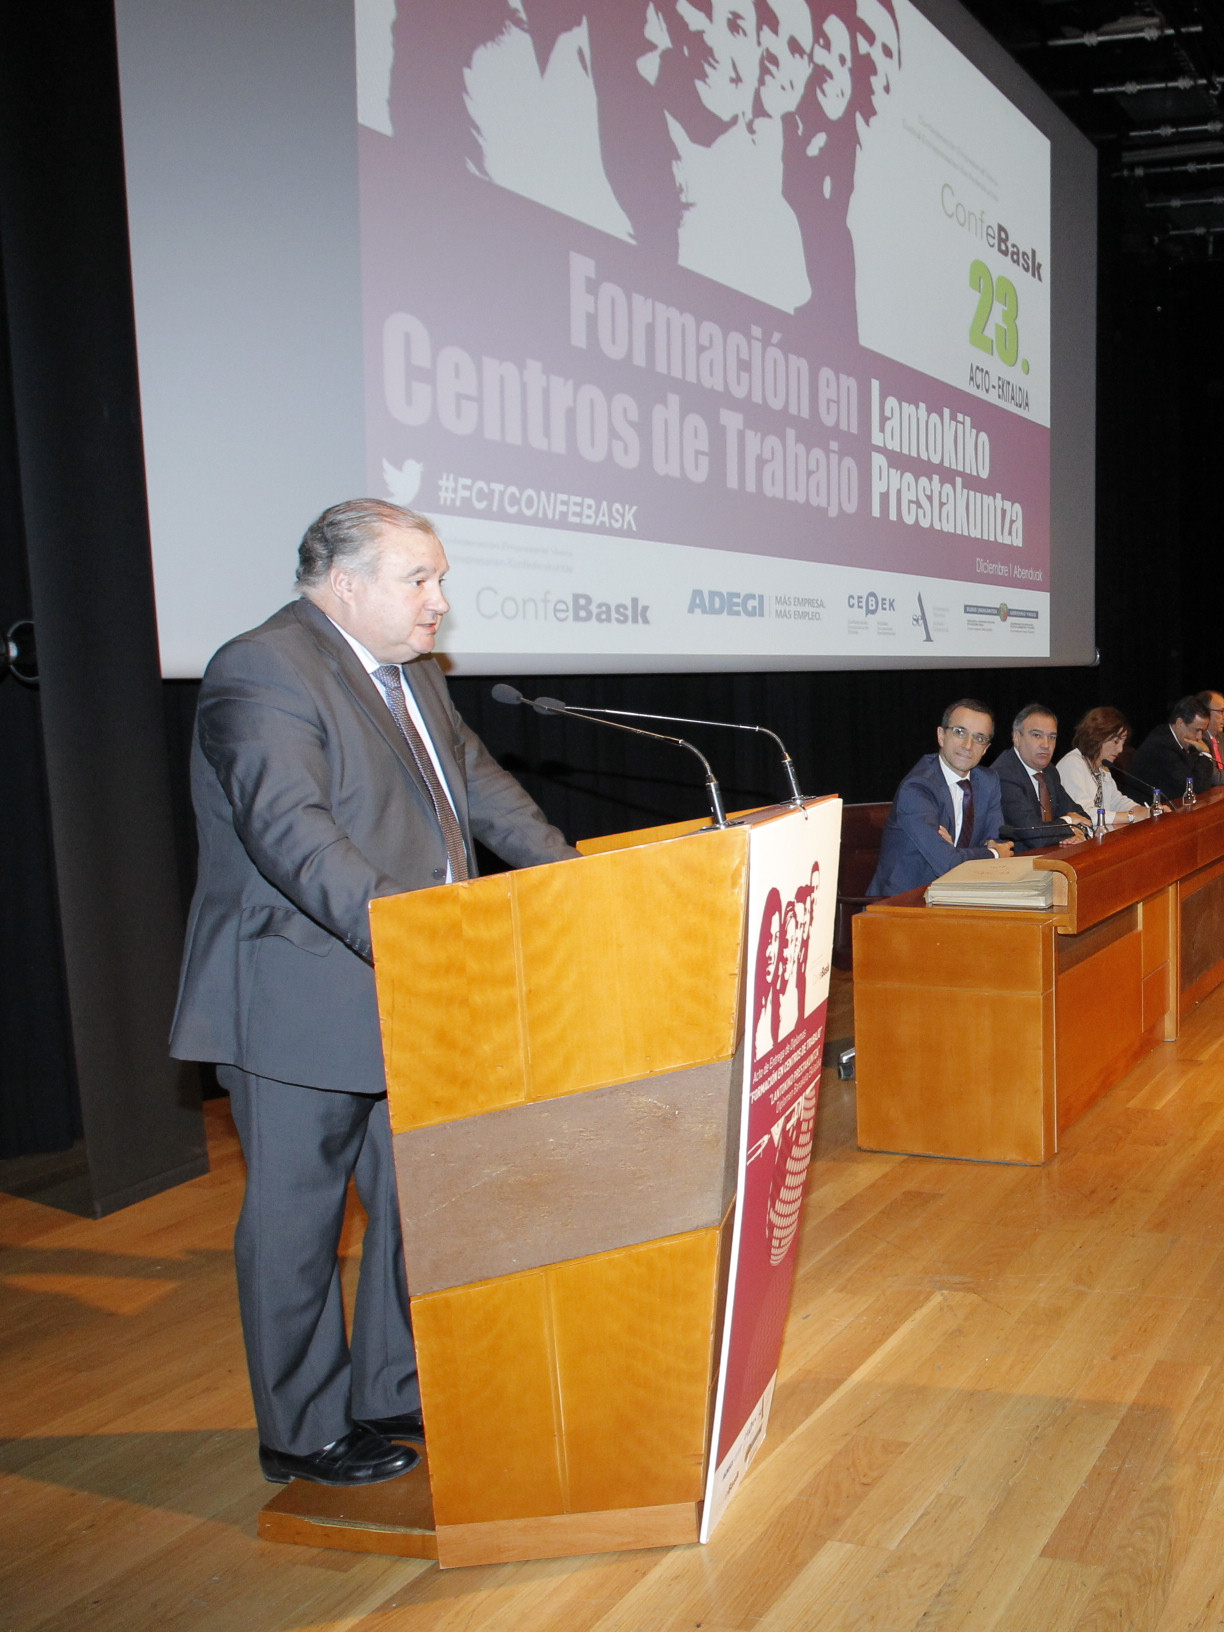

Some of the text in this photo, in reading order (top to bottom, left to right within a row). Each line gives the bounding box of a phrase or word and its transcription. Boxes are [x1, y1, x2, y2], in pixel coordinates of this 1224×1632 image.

[941, 183, 1043, 283] ConfeBask
[969, 258, 1030, 375] 23.
[569, 250, 858, 434] Formación en
[968, 362, 990, 394] ACTO
[998, 376, 1029, 412] EKITALDIA
[383, 312, 858, 517] Centros de Trabajo
[871, 378, 990, 479] Lantokiko
[438, 473, 638, 532] #FCTCONFEBASK
[871, 451, 1023, 547] Prestakuntza
[976, 557, 1009, 577] Diciembre
[476, 586, 650, 625] ConfeBask
[687, 589, 765, 618] ADEGI
[775, 594, 826, 609] MÁS EMPRESA.
[775, 608, 822, 621] MÁS EMPLEO.
[753, 1068, 764, 1084] Acto
[763, 1062, 770, 1075] de
[769, 1050, 785, 1070] Entrega
[777, 1064, 785, 1080] EN
